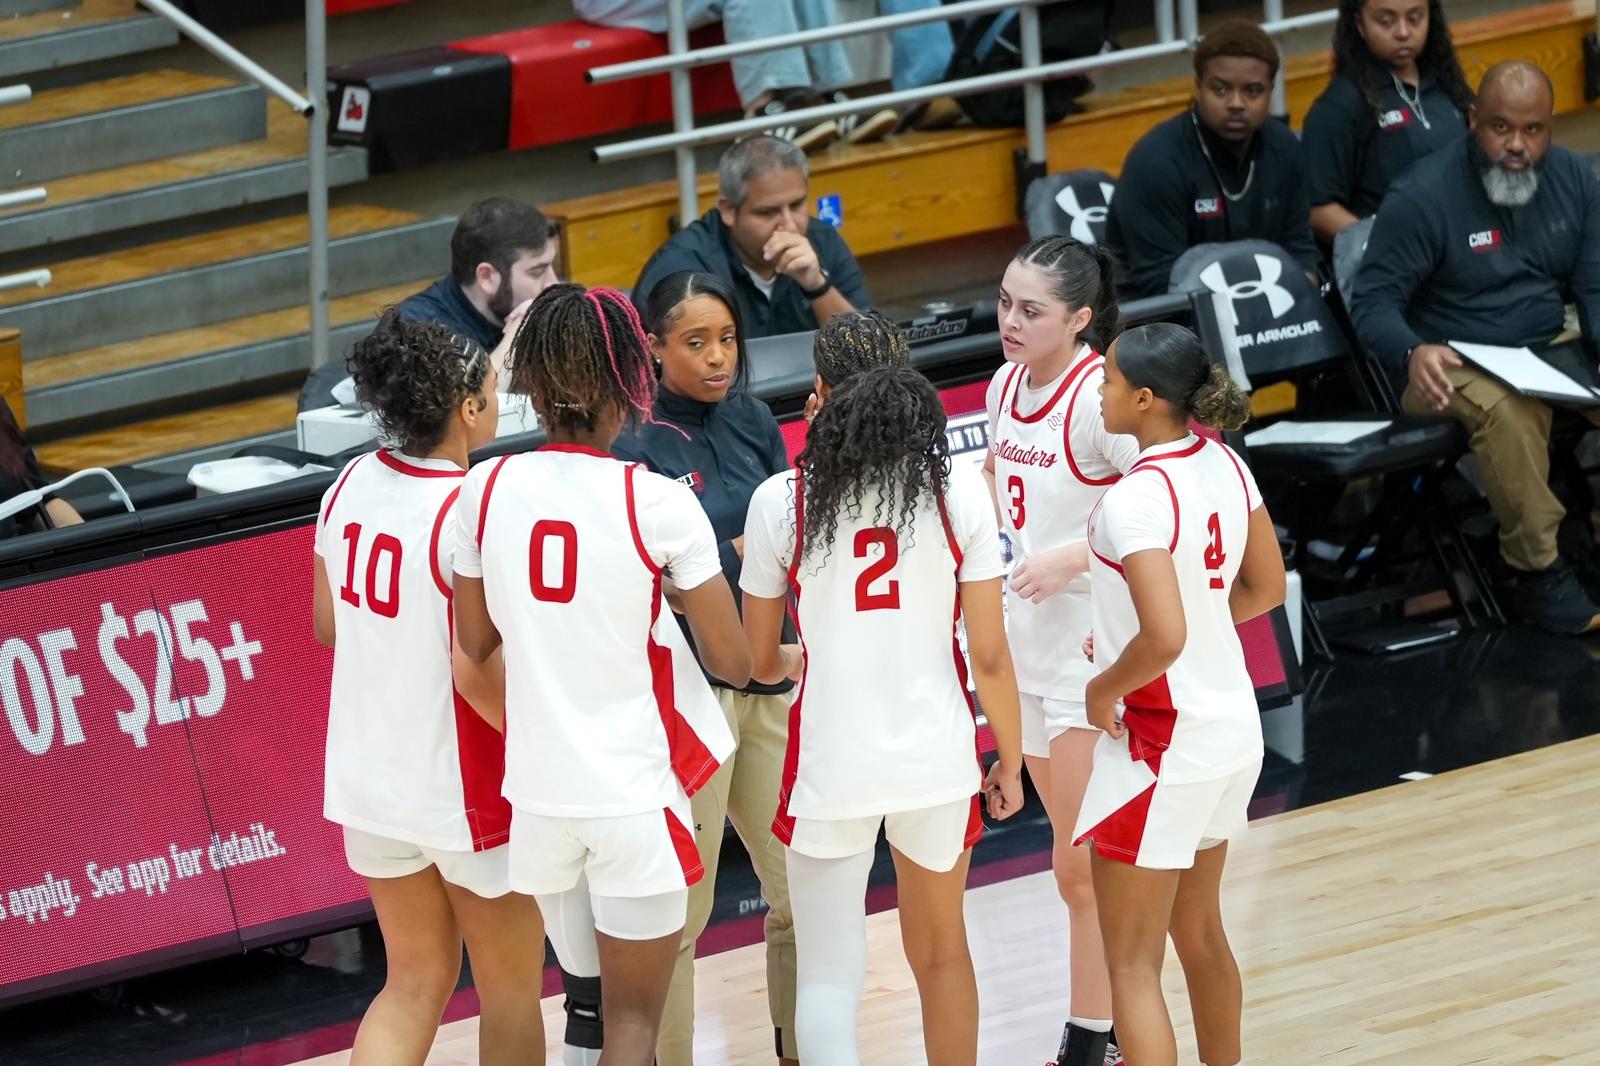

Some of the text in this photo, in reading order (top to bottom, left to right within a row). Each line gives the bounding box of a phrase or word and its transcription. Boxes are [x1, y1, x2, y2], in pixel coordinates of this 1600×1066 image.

[1256, 319, 1321, 345] ARMOUR
[994, 439, 1057, 468] Matadors
[1008, 475, 1025, 530] 3
[341, 521, 403, 619] 10
[529, 519, 578, 603] 0
[853, 526, 900, 612] 2
[0, 598, 263, 756] OF $25+
[86, 861, 125, 898] See
[128, 856, 171, 897] app
[170, 843, 203, 880] for
[207, 821, 287, 870] details.
